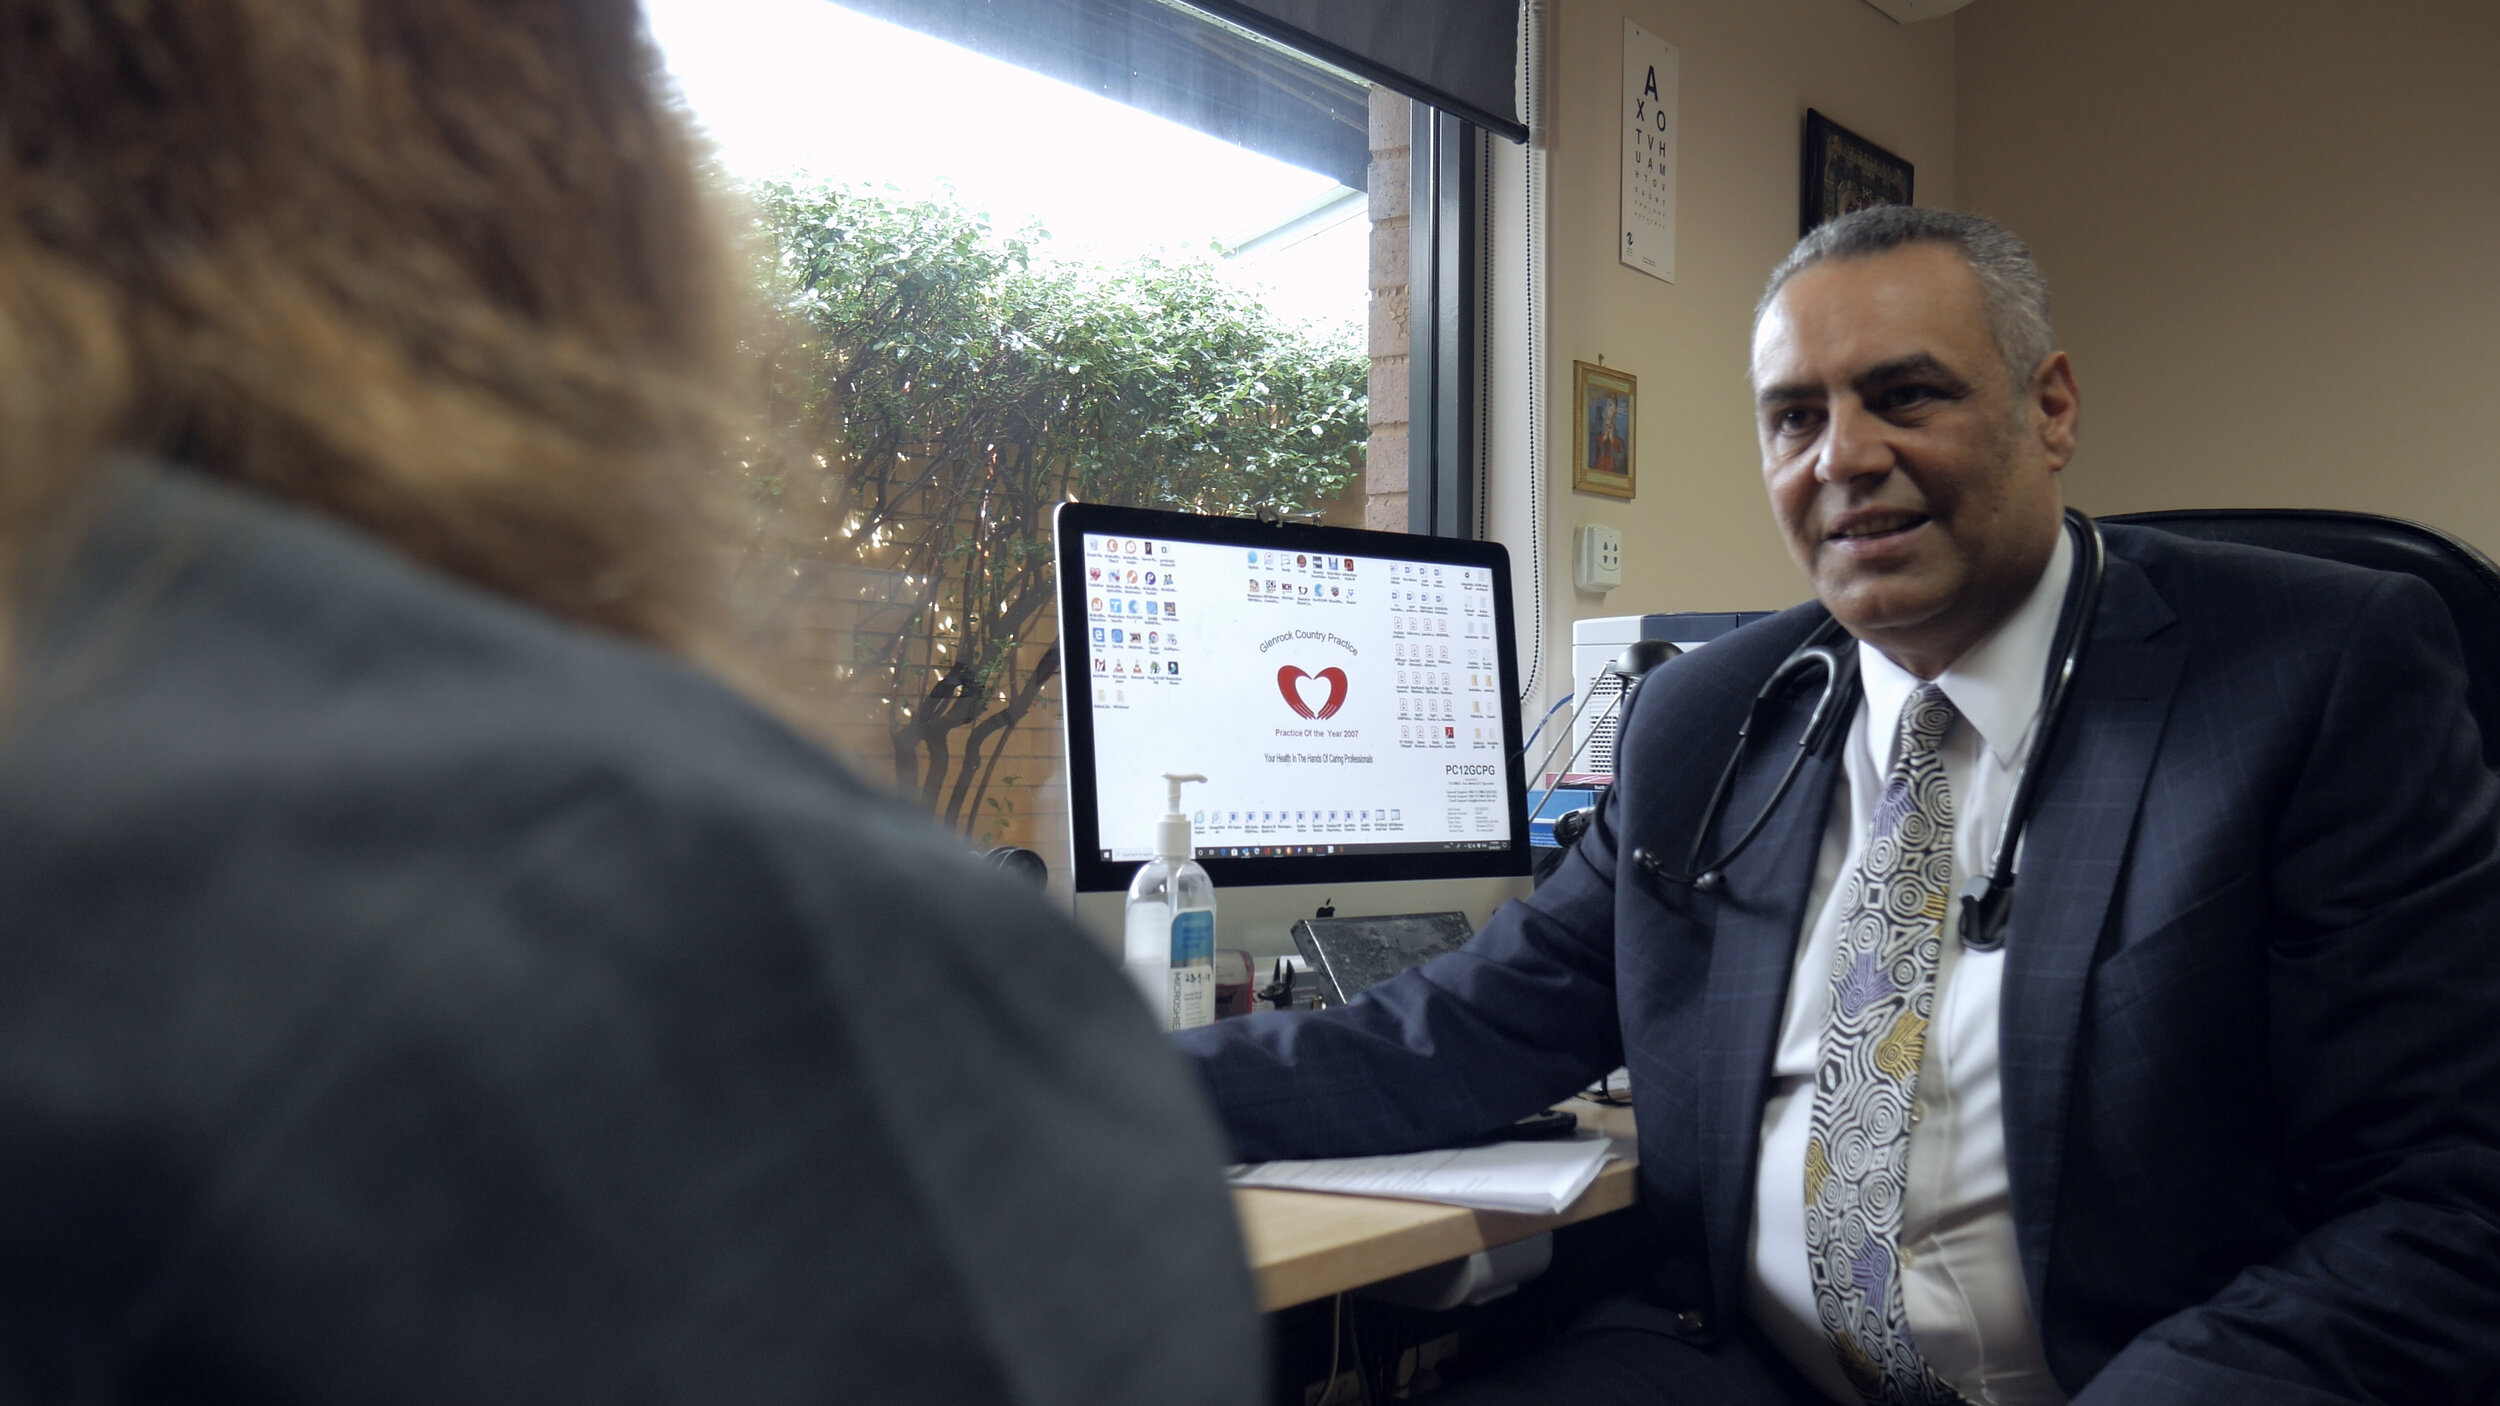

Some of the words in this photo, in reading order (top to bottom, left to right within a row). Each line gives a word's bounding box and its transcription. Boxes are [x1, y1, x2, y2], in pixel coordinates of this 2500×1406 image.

[1644, 65, 1659, 102] A
[1636, 98, 1645, 122] X
[1656, 110, 1667, 132] O
[1636, 128, 1642, 144] T
[1648, 134, 1654, 151] V
[1659, 140, 1666, 157] H
[1636, 150, 1641, 164] U
[1648, 157, 1653, 170] A
[1659, 163, 1665, 176] M
[1259, 630, 1294, 653] Glenrock
[1295, 629, 1326, 643] Country
[1327, 633, 1358, 656] Practice
[1275, 729, 1303, 737] Practice
[1304, 729, 1312, 737] Of
[1313, 729, 1324, 737] the
[1327, 730, 1342, 738] Year
[1343, 730, 1359, 738] 2007
[1264, 753, 1275, 763] Your
[1276, 753, 1291, 763] Health
[1292, 754, 1297, 763] In
[1297, 754, 1306, 763] The
[1307, 754, 1322, 763] Hands
[1323, 754, 1329, 763] Of
[1329, 754, 1344, 765] Caring
[1344, 754, 1374, 764] Professionals
[1445, 765, 1495, 775] PC12GCPG
